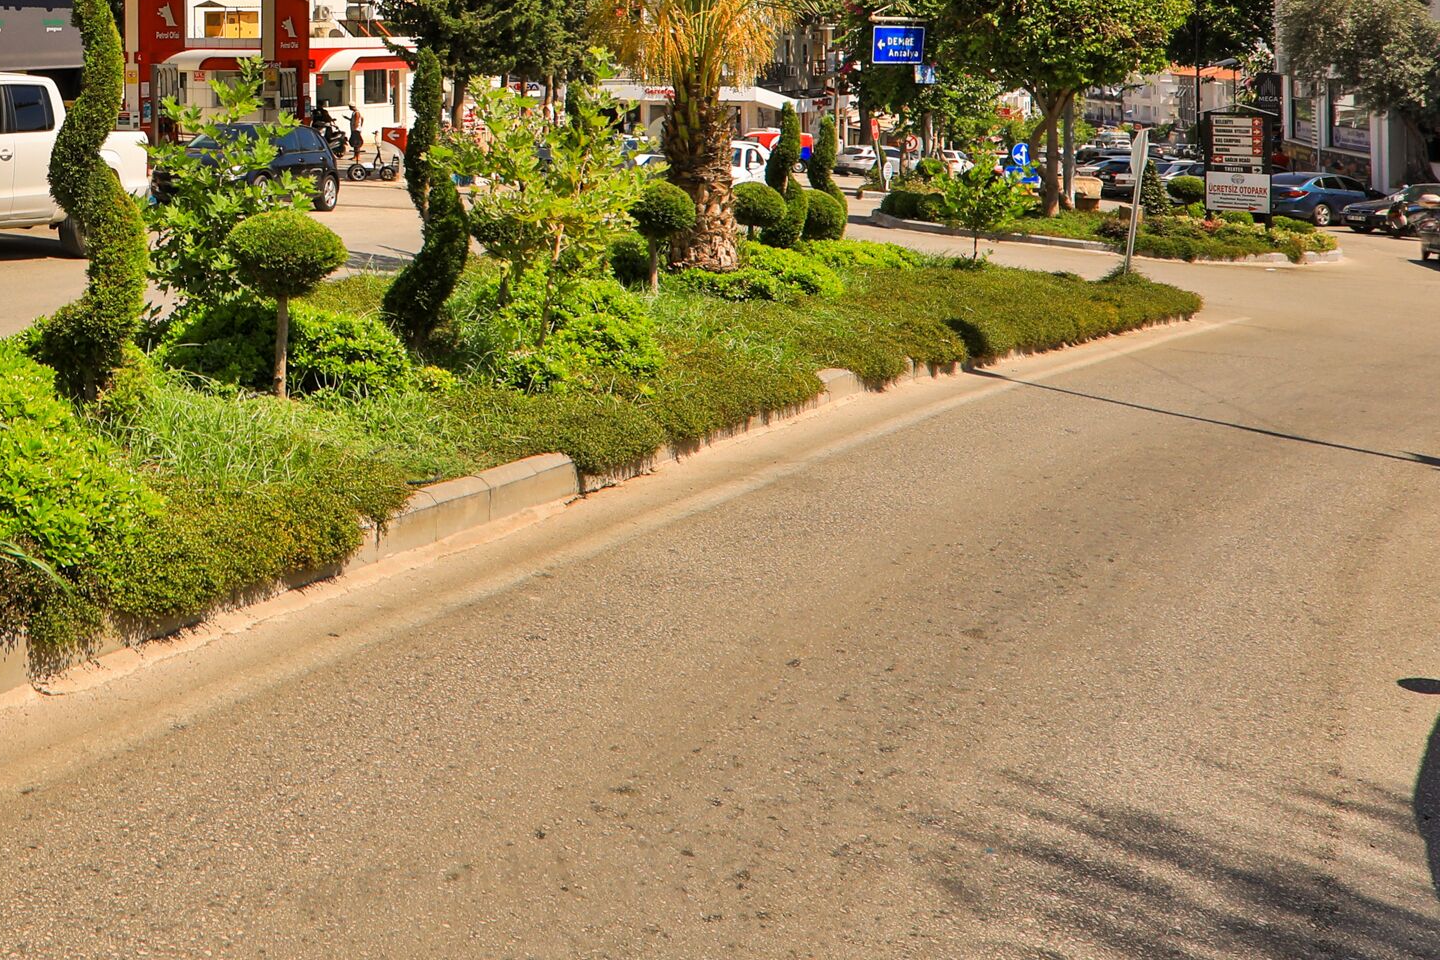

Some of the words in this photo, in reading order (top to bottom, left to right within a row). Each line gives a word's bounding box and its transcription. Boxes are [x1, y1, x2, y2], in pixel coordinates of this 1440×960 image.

[887, 36, 915, 46] DEMRE
[888, 48, 919, 59] Antalya
[1239, 186, 1268, 195] OTOPARK
